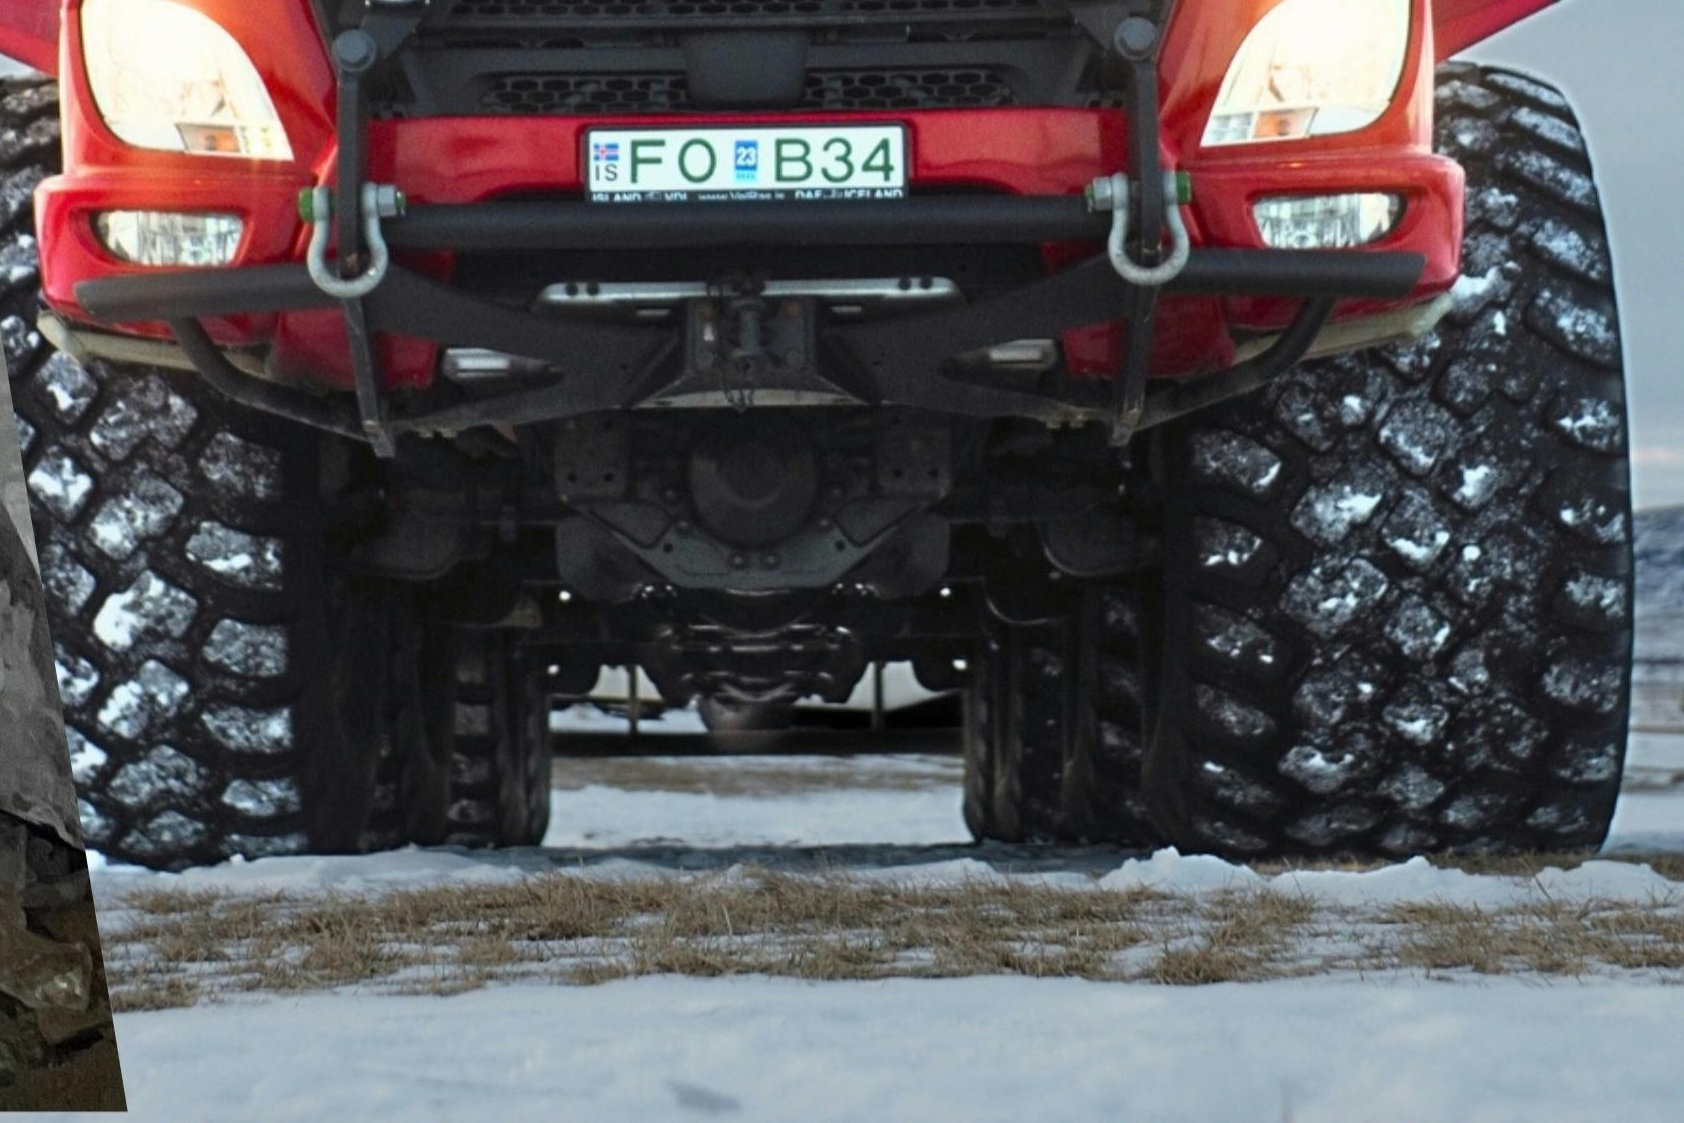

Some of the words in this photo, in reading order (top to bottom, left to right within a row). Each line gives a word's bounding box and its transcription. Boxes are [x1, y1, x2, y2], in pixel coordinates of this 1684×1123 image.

[630, 138, 716, 183] FO
[774, 137, 895, 182] B34
[737, 146, 756, 166] 23
[595, 163, 618, 182] IS
